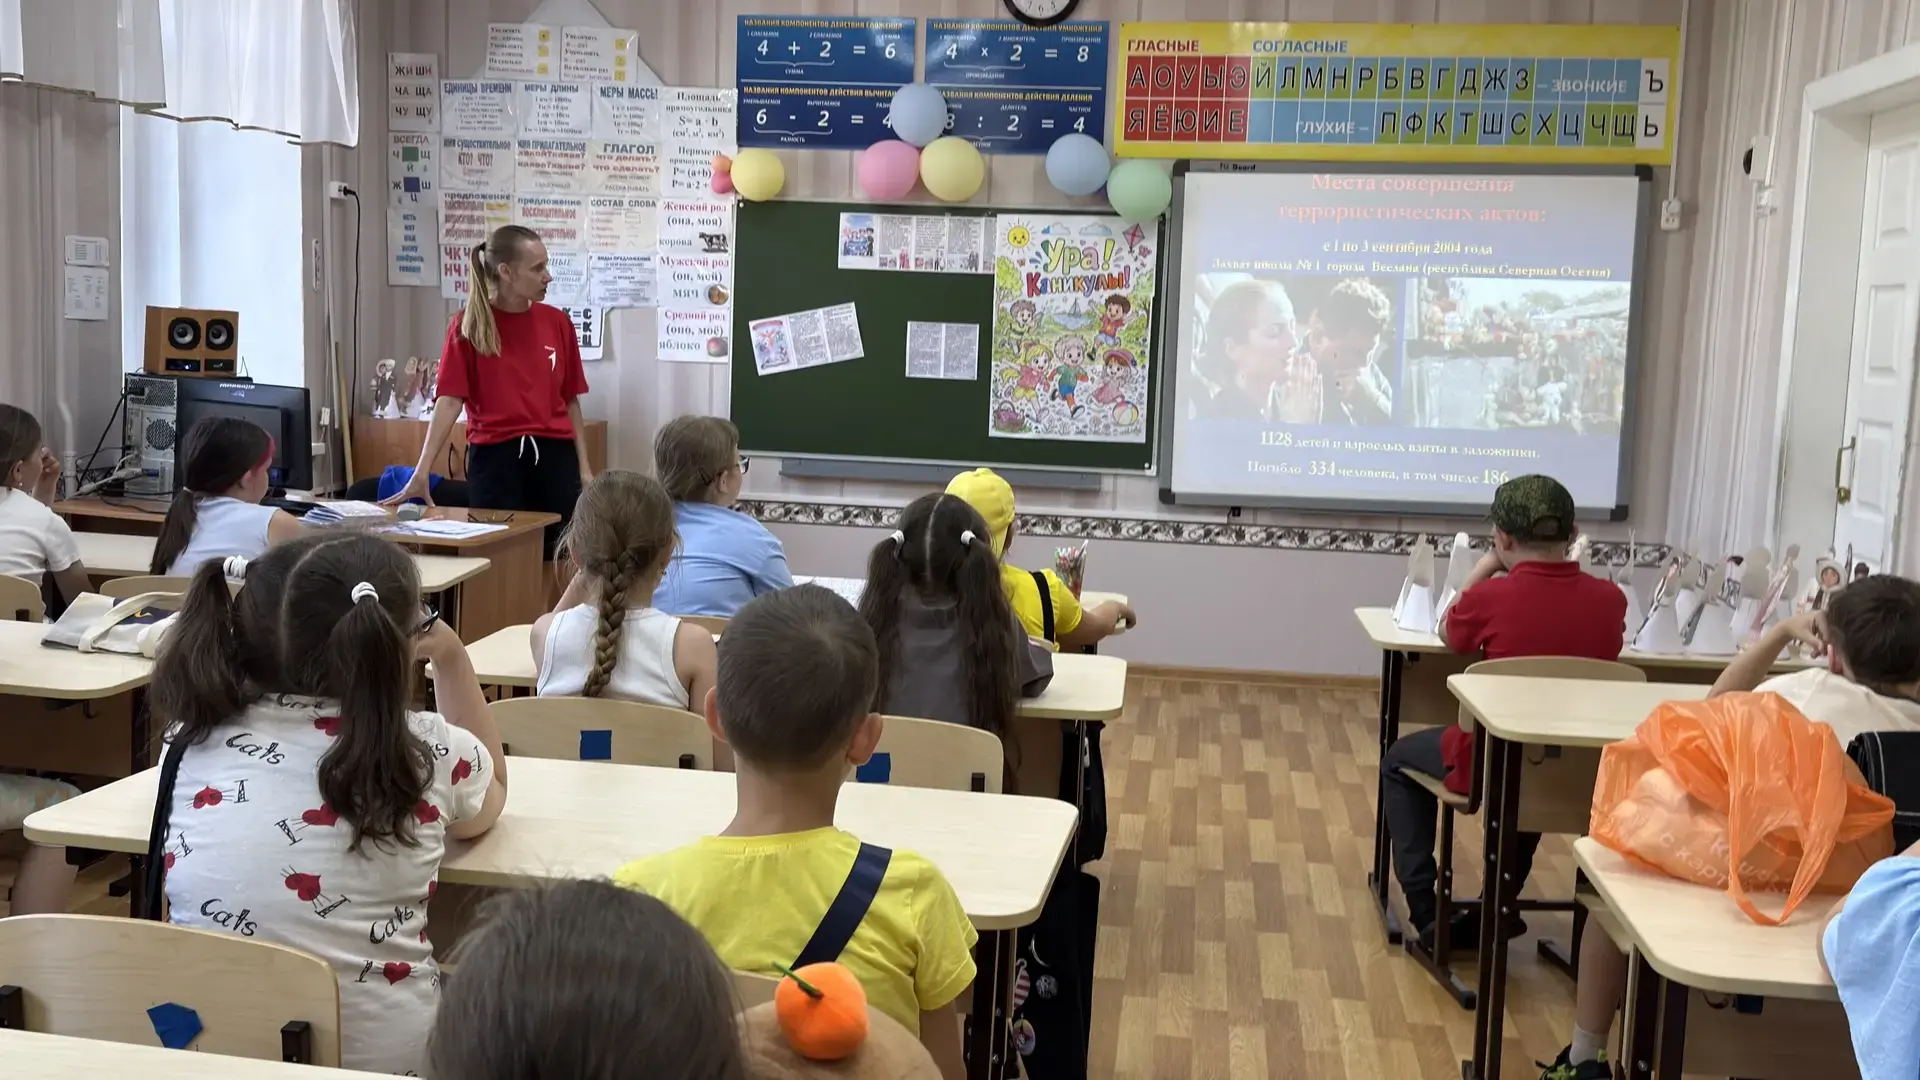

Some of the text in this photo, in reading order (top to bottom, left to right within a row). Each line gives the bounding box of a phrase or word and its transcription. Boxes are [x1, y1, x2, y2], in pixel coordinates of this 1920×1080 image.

[744, 19, 903, 30] НАЗВАНИЯ КОМПОНЕНТОВ ДЕЙСТВИЯ СЛОЖЕНИЯ
[933, 22, 970, 30] НАЗВАНИЯ
[971, 23, 1020, 31] КОМПОНЕНТОВ
[1058, 25, 1102, 33] УМНОЖЕНИЯ
[757, 39, 896, 59] 4 2 6
[1127, 39, 1199, 52] ГЛАСНЫЕ
[1253, 40, 1348, 53] СОГЛАСНЫЕ
[946, 43, 1089, 62] 4 2 8
[395, 66, 432, 76] ЖИ ШИ
[1129, 61, 1627, 95] А О У Ы Э Й Л М Н Р Б В Г Д Ж З ЗВОНКИЕ
[395, 84, 432, 97] ЧА ЩА
[444, 83, 512, 95] ЕДИНИЦЫ ВРЕМЕНИ
[524, 83, 579, 94] МЕРЫ ДЛИНЫ
[600, 86, 624, 98] МЕРЫ
[744, 87, 863, 97] НАЗВАНИЯ КОМПОНЕНТОВ ДЕЙСТВИЯ
[677, 92, 721, 101] Площадь
[974, 92, 1093, 102] КОМПОНЕНТОВ ДЕЙСТВИЯ ДЕЛЕНИЯ
[395, 107, 432, 119] ЧУ ЩУ
[666, 105, 732, 114] прямоугольника
[756, 108, 892, 129] 6 2 4
[1007, 115, 1019, 131] 2
[1073, 116, 1085, 132] 4
[1128, 104, 1356, 135] Я Ё Ю И Е ГЛУХИЕ
[393, 135, 429, 145] ВСЕГДА
[444, 139, 455, 148] ИМЯ
[518, 140, 586, 152] ИМЯ ПРИЛАГАТЕЛЬНОЕ
[603, 143, 655, 154] ГЛАГОЛ
[615, 154, 657, 162] делать?
[593, 164, 660, 173] что сделать?
[1311, 174, 1516, 197] Места совершения
[590, 199, 657, 208] СОСТАВ СЛОВА
[663, 202, 727, 212] Женский род
[1279, 204, 1546, 224] террористических актов:
[668, 215, 722, 227] (она, моя)
[659, 237, 692, 248] корова
[1323, 240, 1493, 257] с 1 по 3 сентября 2004 года
[660, 256, 729, 268] Мужской род
[1041, 238, 1115, 275] Ура!
[1212, 258, 1250, 270] Захват
[1254, 261, 1292, 272] школы
[1296, 260, 1312, 271] №
[1316, 260, 1320, 271] 1
[1327, 263, 1365, 273] города
[1423, 264, 1496, 278] (республика
[1499, 264, 1557, 277] Северная
[1560, 265, 1611, 279] Осетия)
[673, 271, 694, 282] (он,
[1026, 266, 1131, 297] Каникулы!
[673, 289, 699, 298] мяч
[665, 311, 725, 322] Средний род
[666, 324, 724, 337] (оно, моё)
[659, 340, 700, 350] яблоко
[1260, 431, 1540, 459] 1128 детей и взрослых взяты в заложники.
[1248, 461, 1509, 485] Погибло 334 человека, в том числе 186
[225, 733, 285, 765] Cats
[200, 898, 258, 937] Cats
[369, 905, 414, 945] Cats
